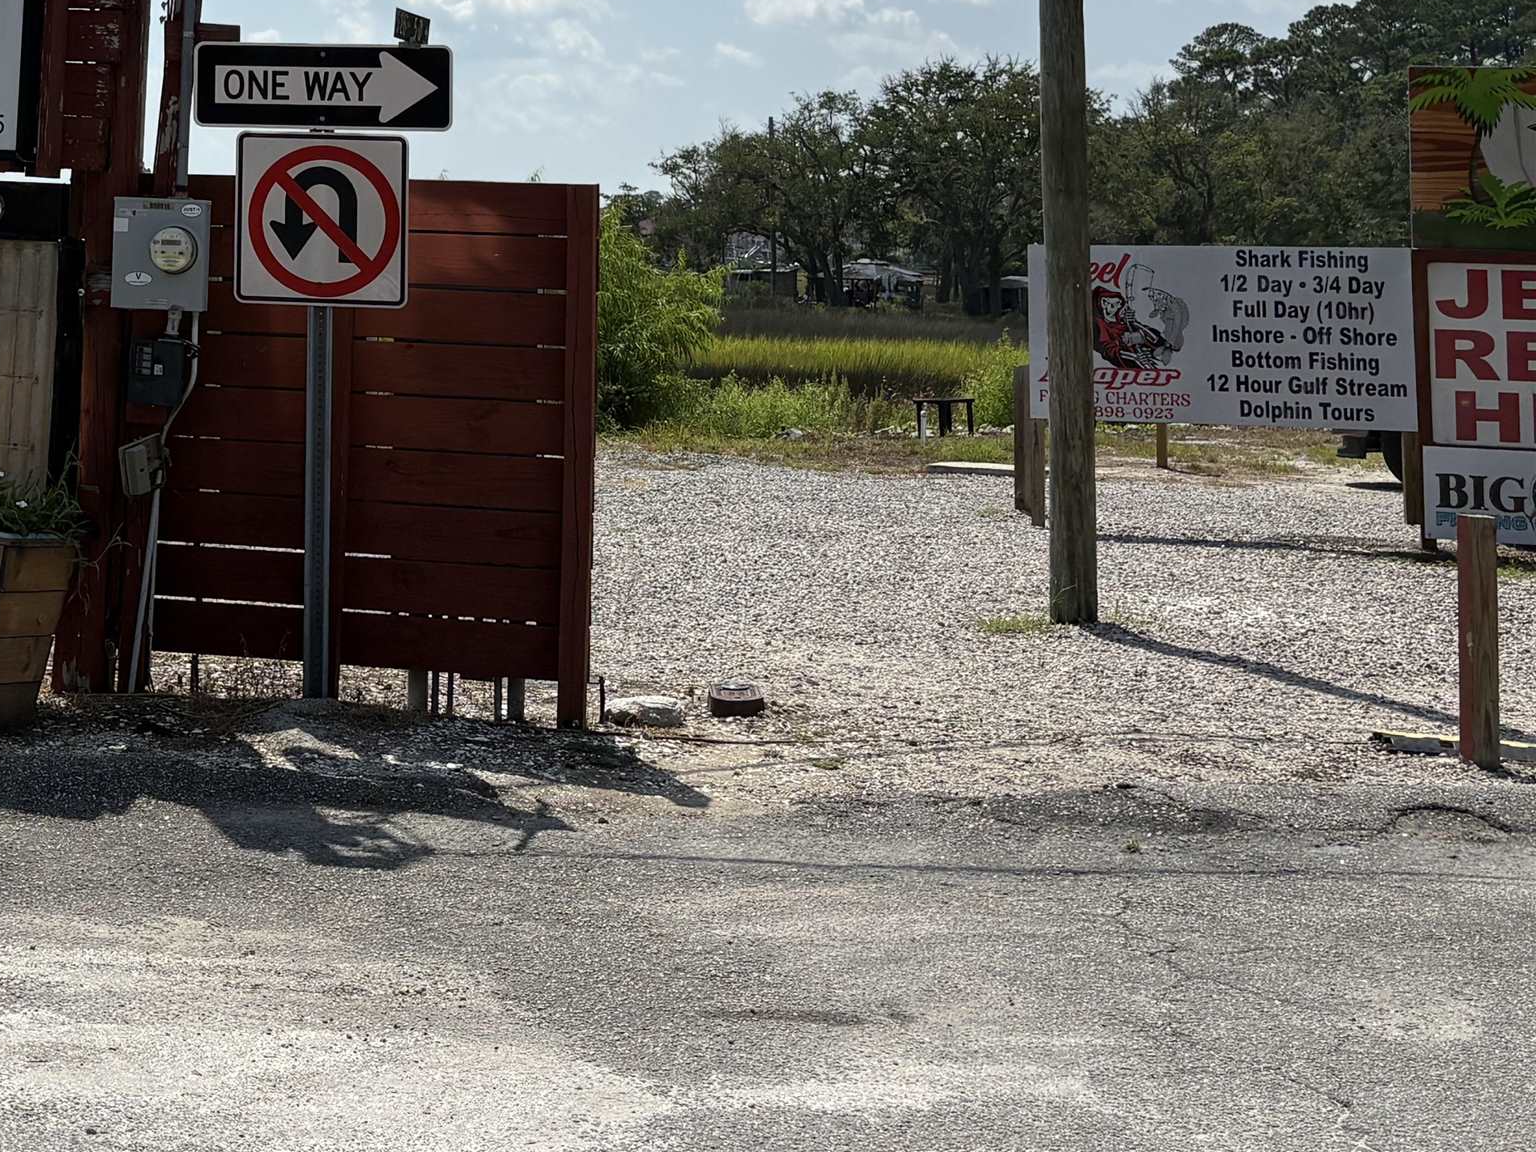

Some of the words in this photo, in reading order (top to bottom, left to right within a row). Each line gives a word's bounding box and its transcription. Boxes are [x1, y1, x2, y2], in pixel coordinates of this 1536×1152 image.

[223, 69, 290, 100] ONE
[303, 70, 373, 101] WAY
[1089, 253, 1133, 288] eel
[1235, 249, 1292, 268] Shark
[1298, 250, 1369, 273] Fishing
[1220, 274, 1248, 293] 1/2
[1257, 274, 1293, 297] Day
[1313, 276, 1341, 294] 3/4
[1348, 276, 1385, 299] Day
[1233, 300, 1267, 319] Full
[1274, 301, 1310, 323] Day
[1316, 301, 1374, 325] (10hr)
[1212, 325, 1285, 344] Inshore
[1303, 326, 1333, 345] Off
[1339, 327, 1398, 346] Shore
[1231, 350, 1302, 369] Bottom
[1309, 352, 1380, 376] Fishing
[1207, 374, 1230, 392] 12
[1236, 375, 1282, 394] Hour
[1288, 376, 1329, 395] Gulf
[1335, 377, 1408, 397] Stream
[1105, 391, 1191, 407] CHARTERS
[1240, 400, 1313, 423] Dolphin
[1319, 402, 1375, 422] Tours
[1455, 391, 1536, 443] H
[1435, 473, 1528, 513] BIG
